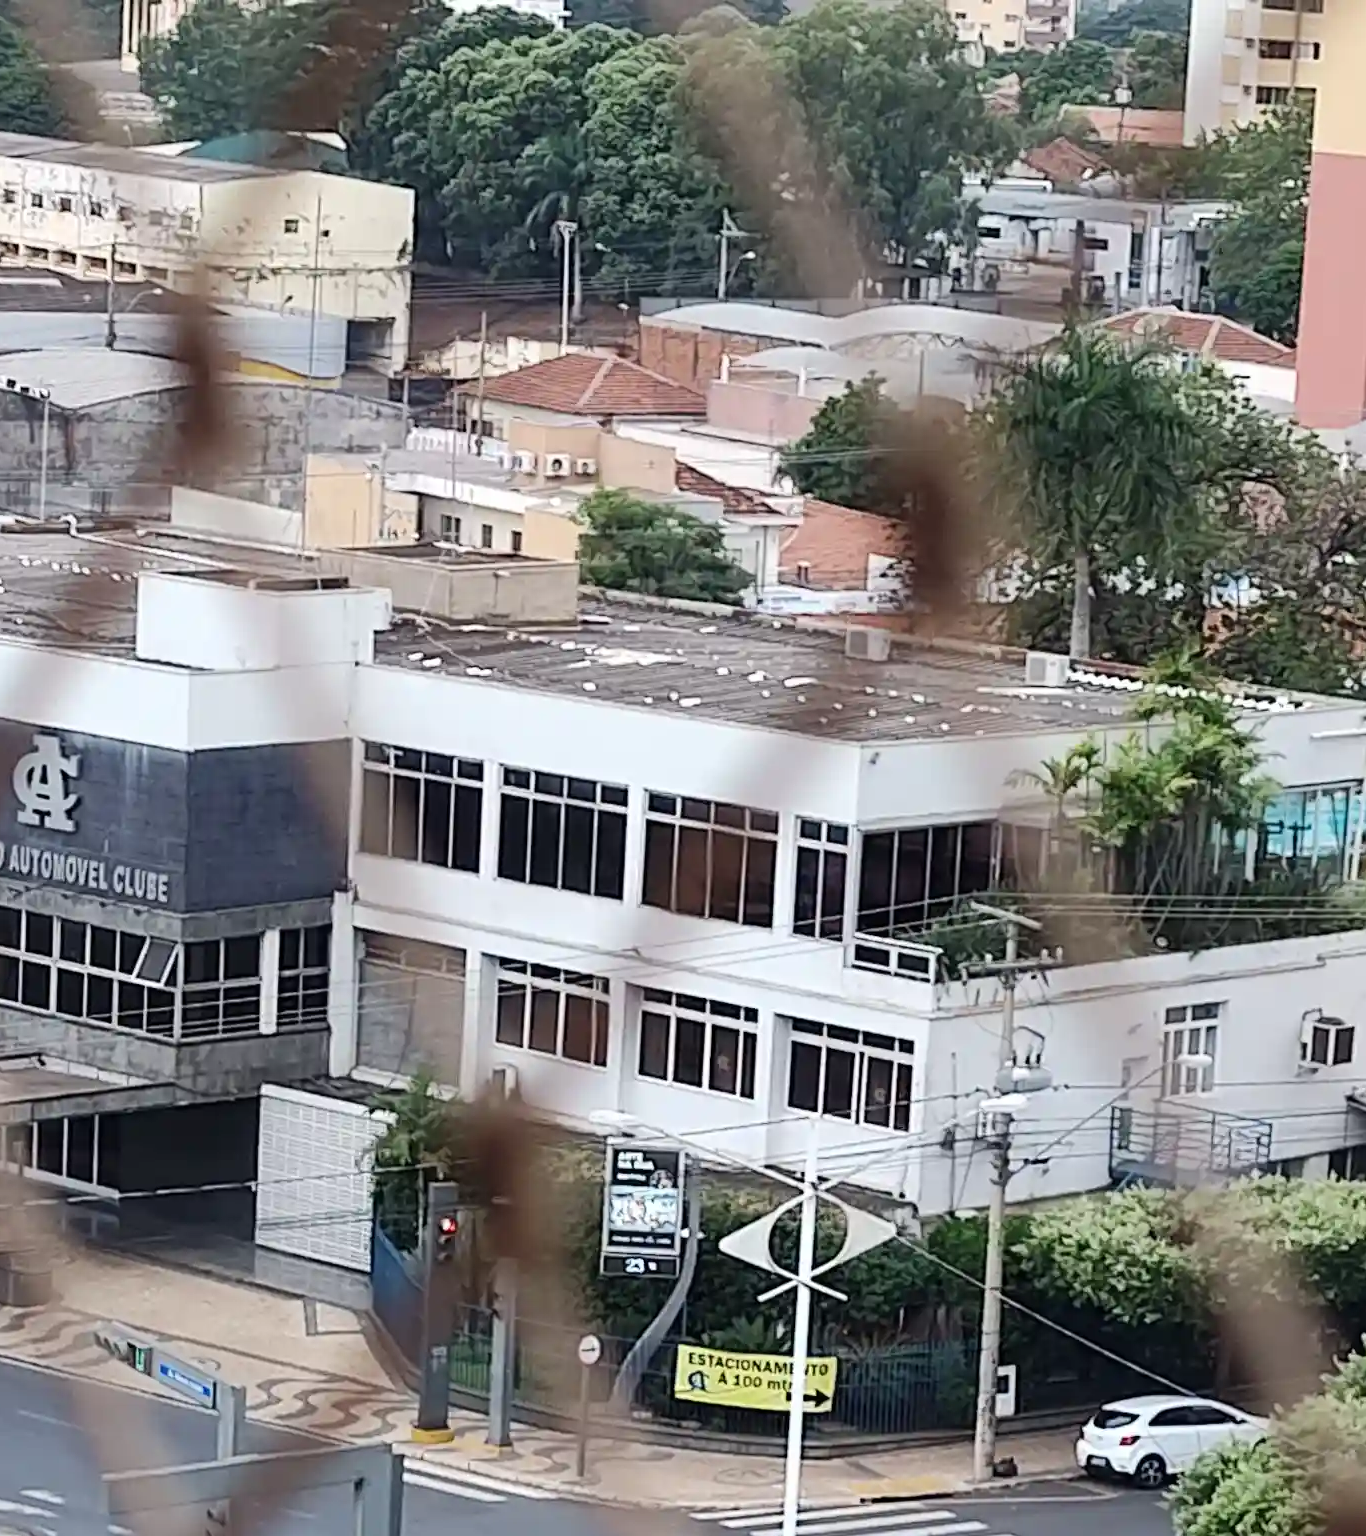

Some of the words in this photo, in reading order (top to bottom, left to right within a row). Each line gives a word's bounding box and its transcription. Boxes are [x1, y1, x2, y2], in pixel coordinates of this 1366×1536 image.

[8, 843, 108, 890] AUTOMOVEL
[113, 865, 168, 902] CLUBE
[732, 1373, 762, 1388] 100
